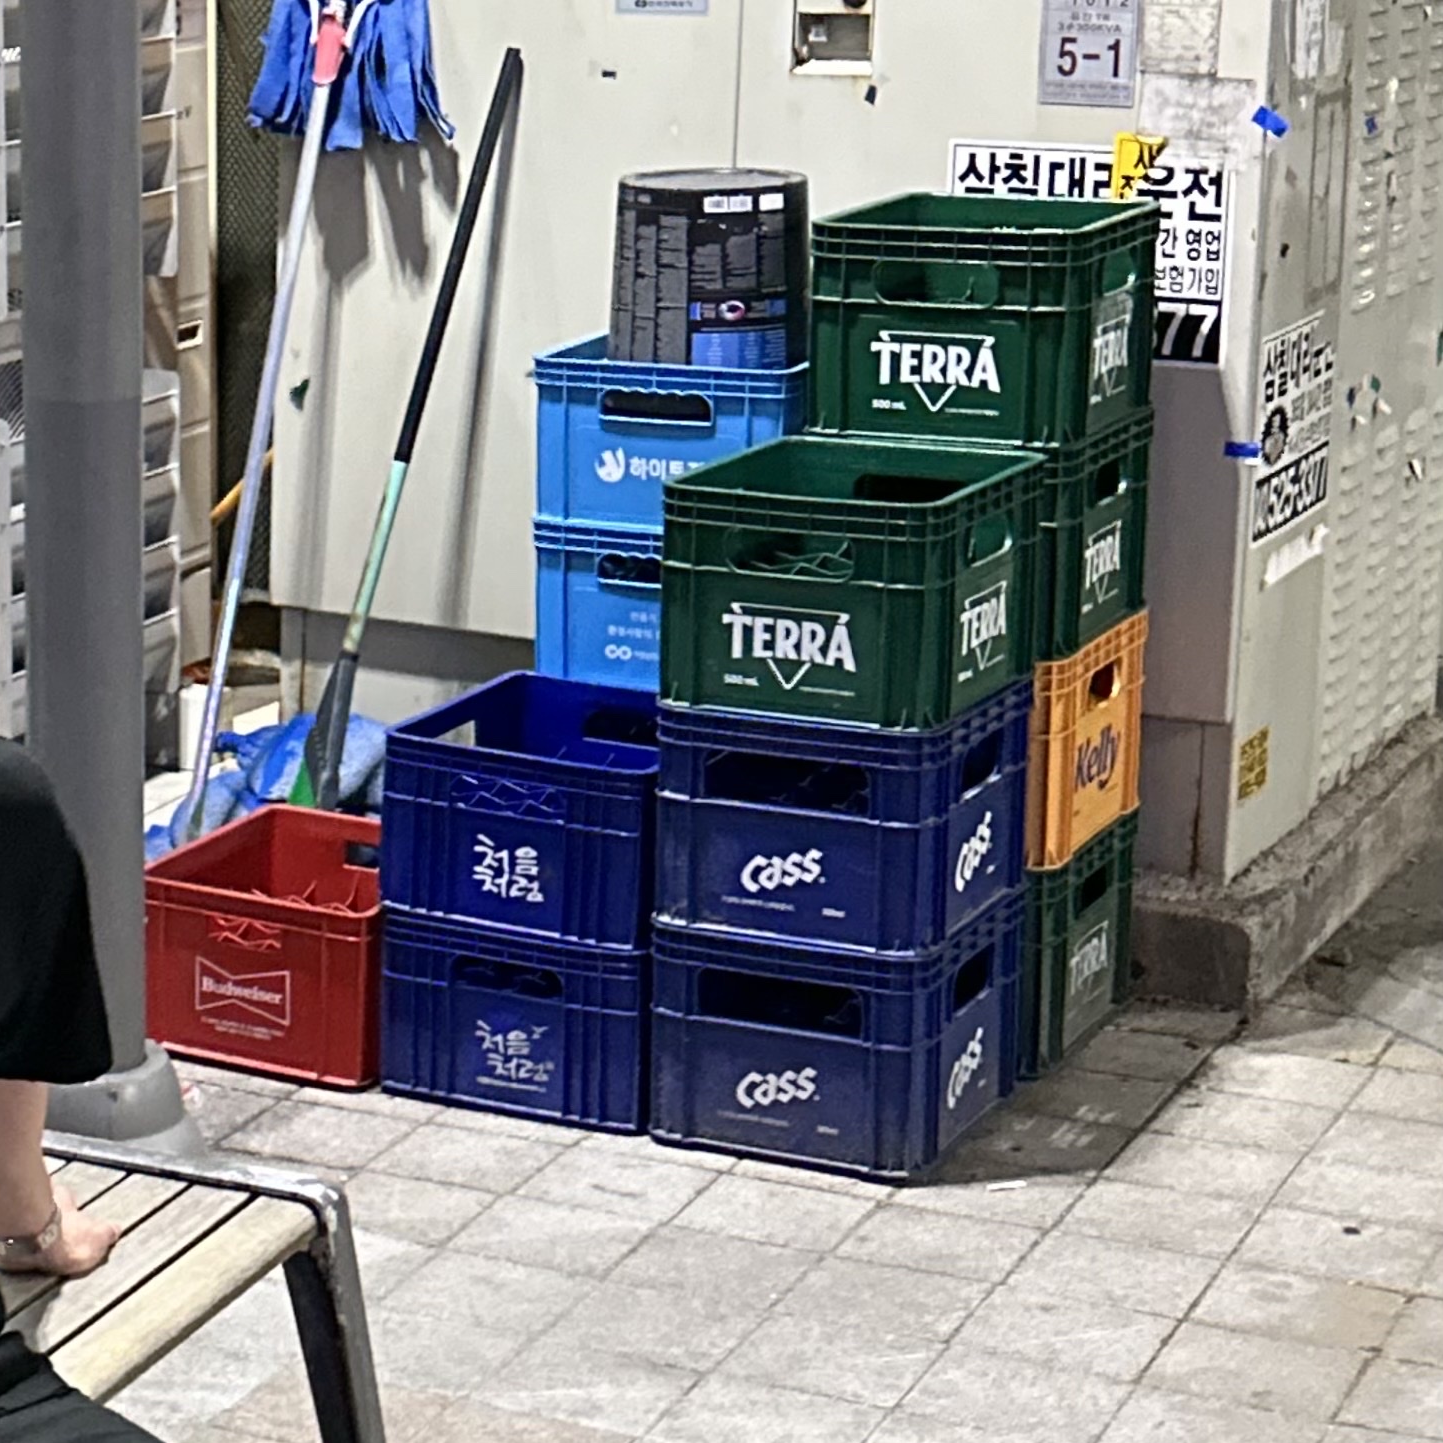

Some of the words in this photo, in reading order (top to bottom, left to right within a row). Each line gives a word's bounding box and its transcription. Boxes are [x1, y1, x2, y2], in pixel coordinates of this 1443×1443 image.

[1057, 36, 1121, 78] 5-1
[1185, 228, 1221, 262] 영업
[1153, 301, 1219, 358] 77
[870, 340, 1001, 394] TERRA
[1084, 527, 1121, 591] TERRA
[721, 612, 857, 673] TERRA
[960, 591, 1007, 657] TERRA
[1075, 723, 1121, 792] Kelly
[472, 833, 540, 873] 처음
[740, 847, 825, 893] Cass
[471, 865, 545, 903] 처럼
[201, 975, 283, 1005] Budweiser
[474, 1019, 531, 1056] 처음
[486, 1052, 550, 1083] 처럼
[735, 1066, 819, 1109] Cass
